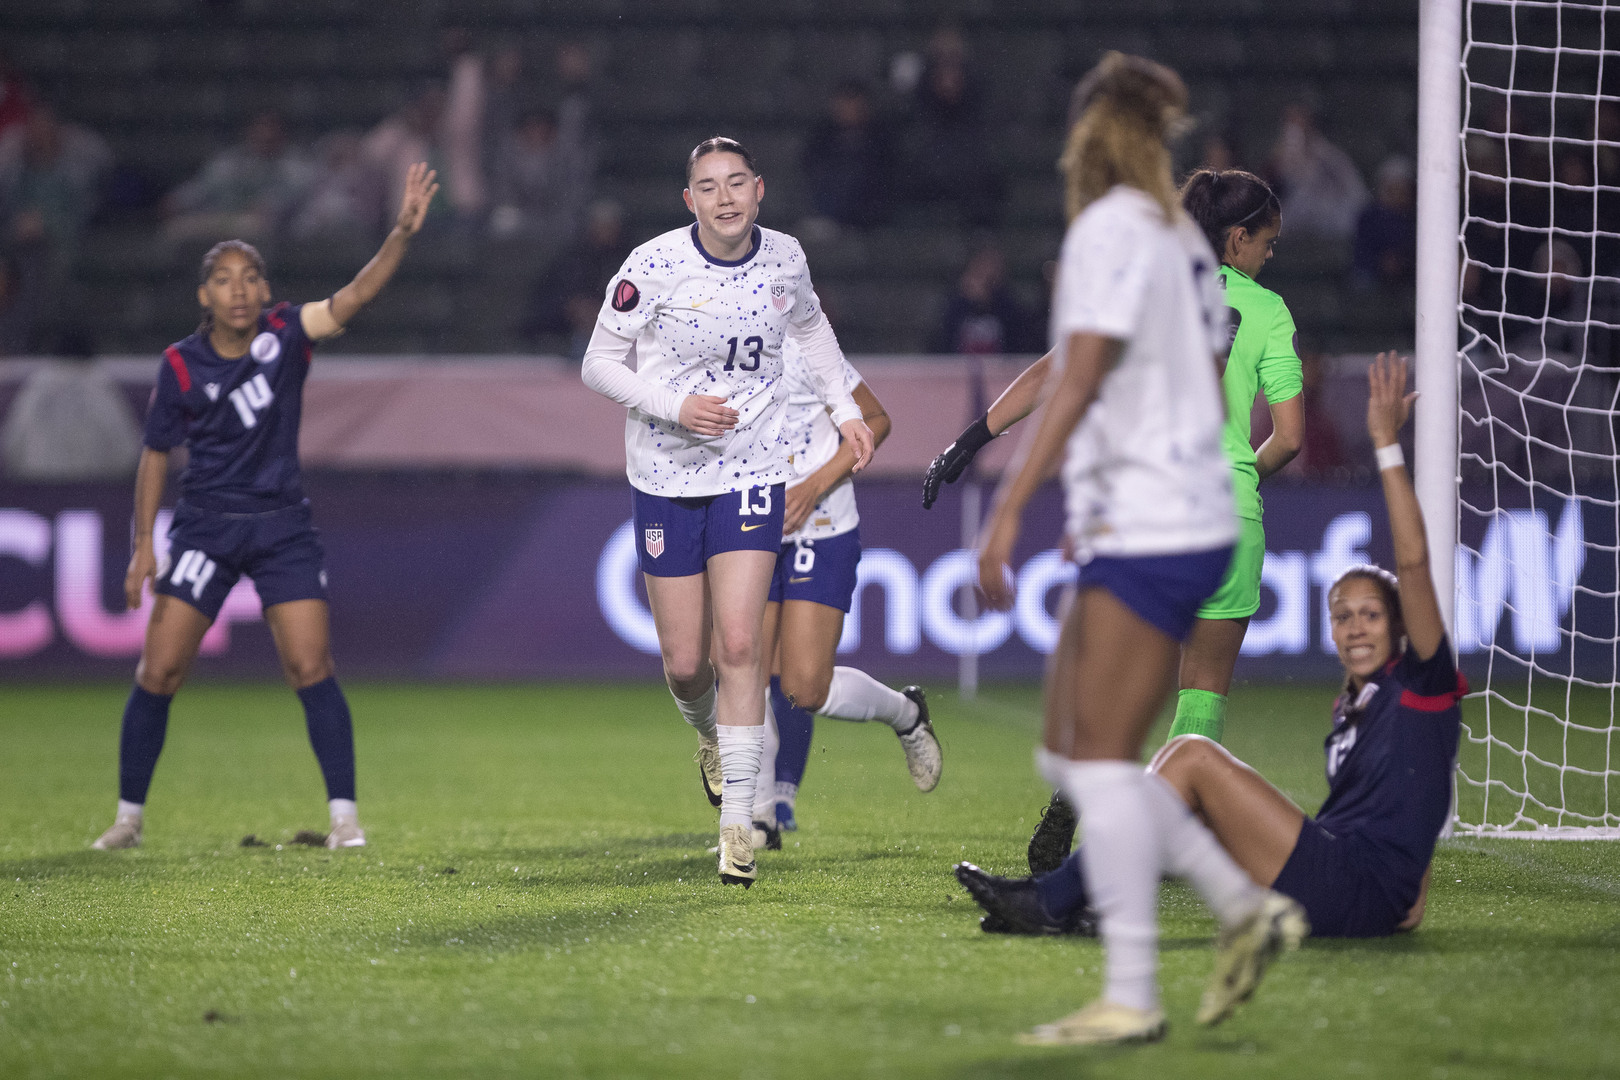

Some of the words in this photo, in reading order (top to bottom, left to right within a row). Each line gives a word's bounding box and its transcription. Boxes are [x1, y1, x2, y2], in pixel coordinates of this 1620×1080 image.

[771, 285, 786, 297] USA
[723, 336, 764, 372] 13
[228, 373, 275, 429] 14
[738, 485, 772, 516] 13
[646, 530, 662, 542] USA
[794, 539, 816, 574] 6
[169, 550, 217, 600] 14
